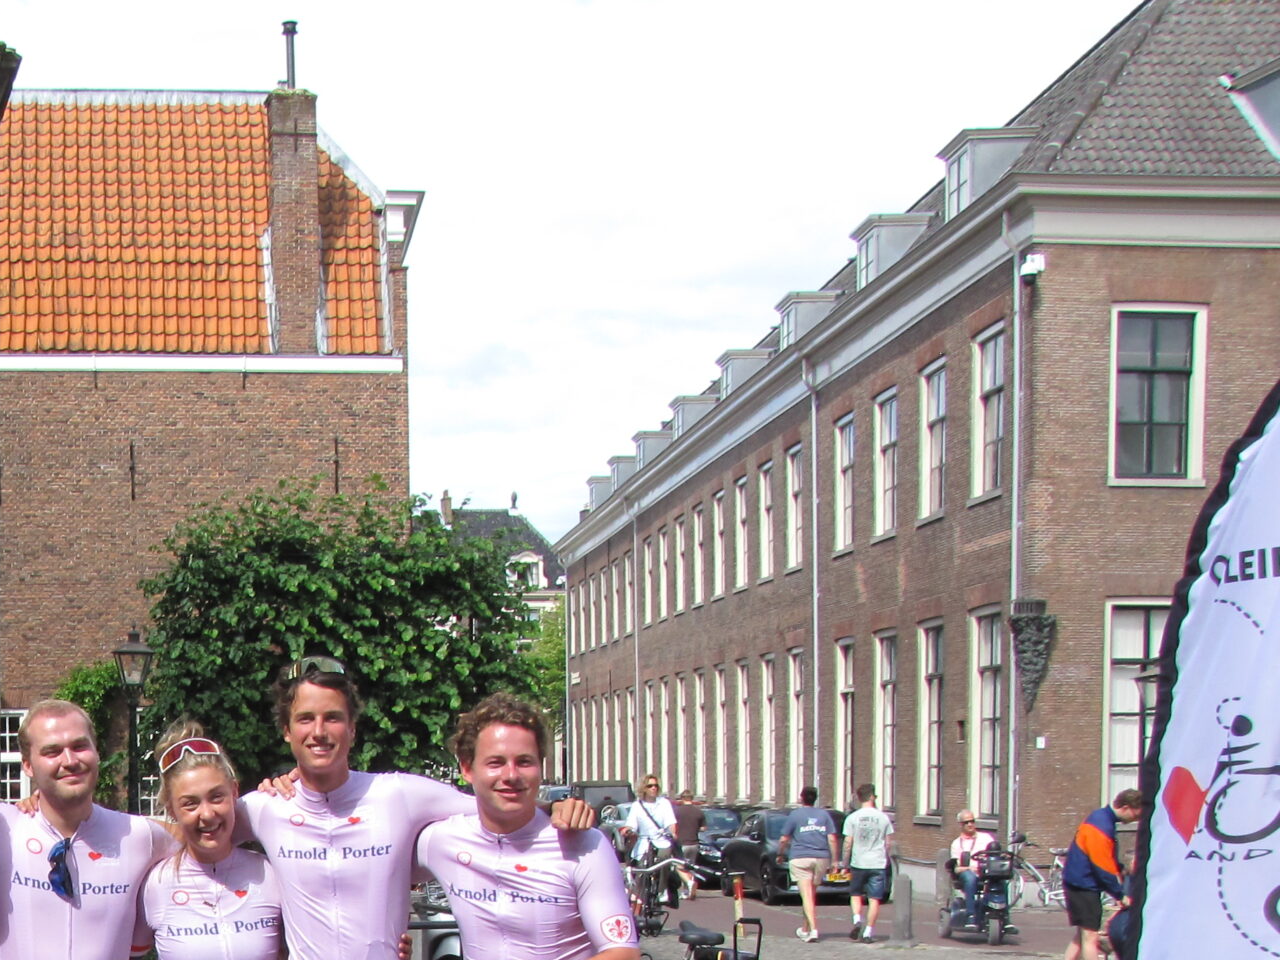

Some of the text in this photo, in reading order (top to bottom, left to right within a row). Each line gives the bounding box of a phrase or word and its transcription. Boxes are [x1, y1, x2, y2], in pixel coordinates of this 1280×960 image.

[277, 844, 392, 860] Arnold Porter
[12, 871, 130, 895] Arno Porter
[449, 883, 561, 903] Arnold Porter
[166, 917, 276, 937] Arnold Porter
